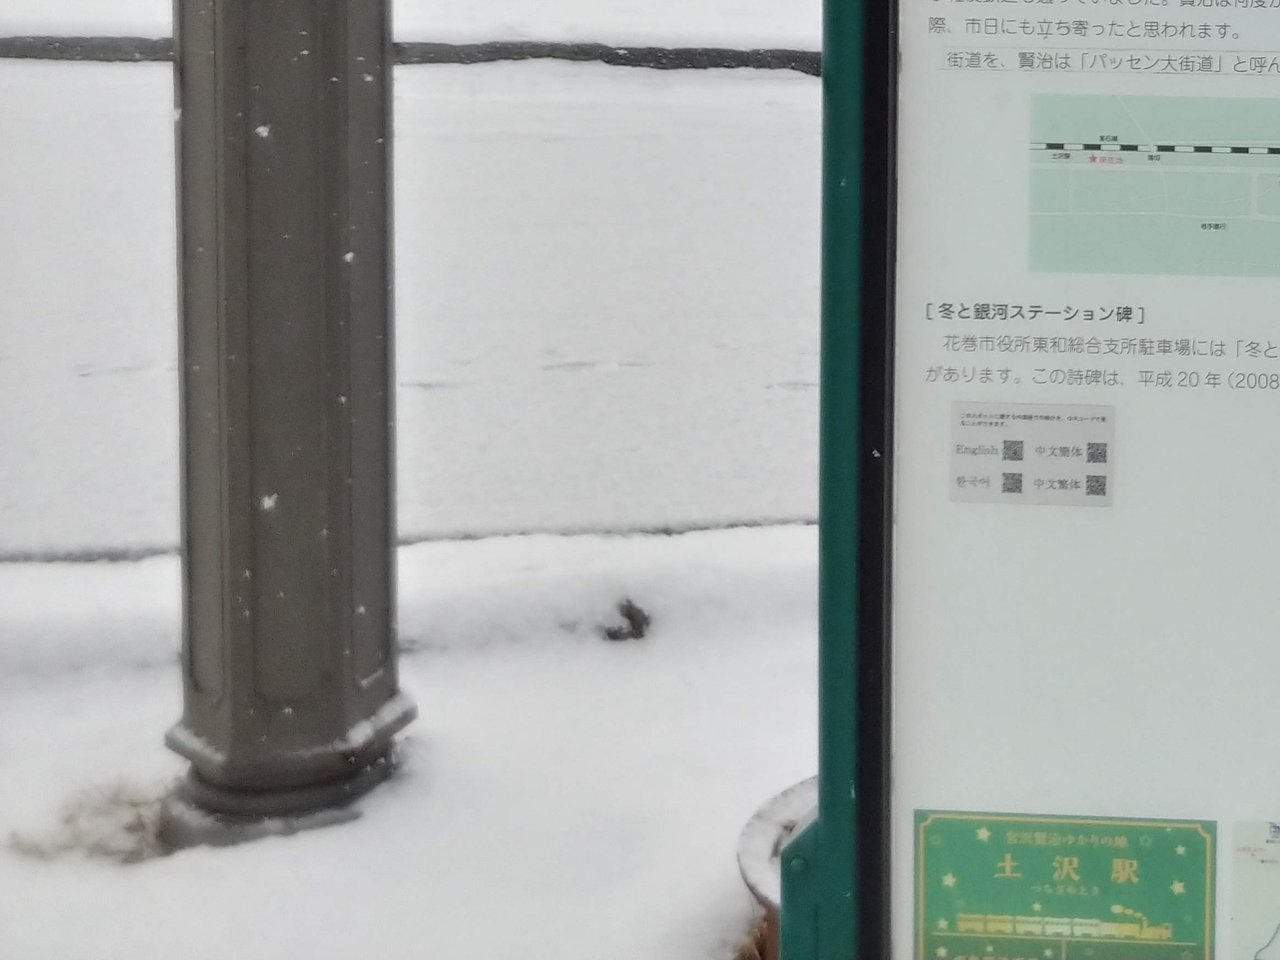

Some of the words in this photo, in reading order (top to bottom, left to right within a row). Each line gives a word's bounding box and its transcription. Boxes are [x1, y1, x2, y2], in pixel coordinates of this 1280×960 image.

[928, 16, 1240, 40] 際、市日にも立ち寄ったと思われます。
[955, 444, 999, 457] English
[956, 475, 991, 489] 한국어
